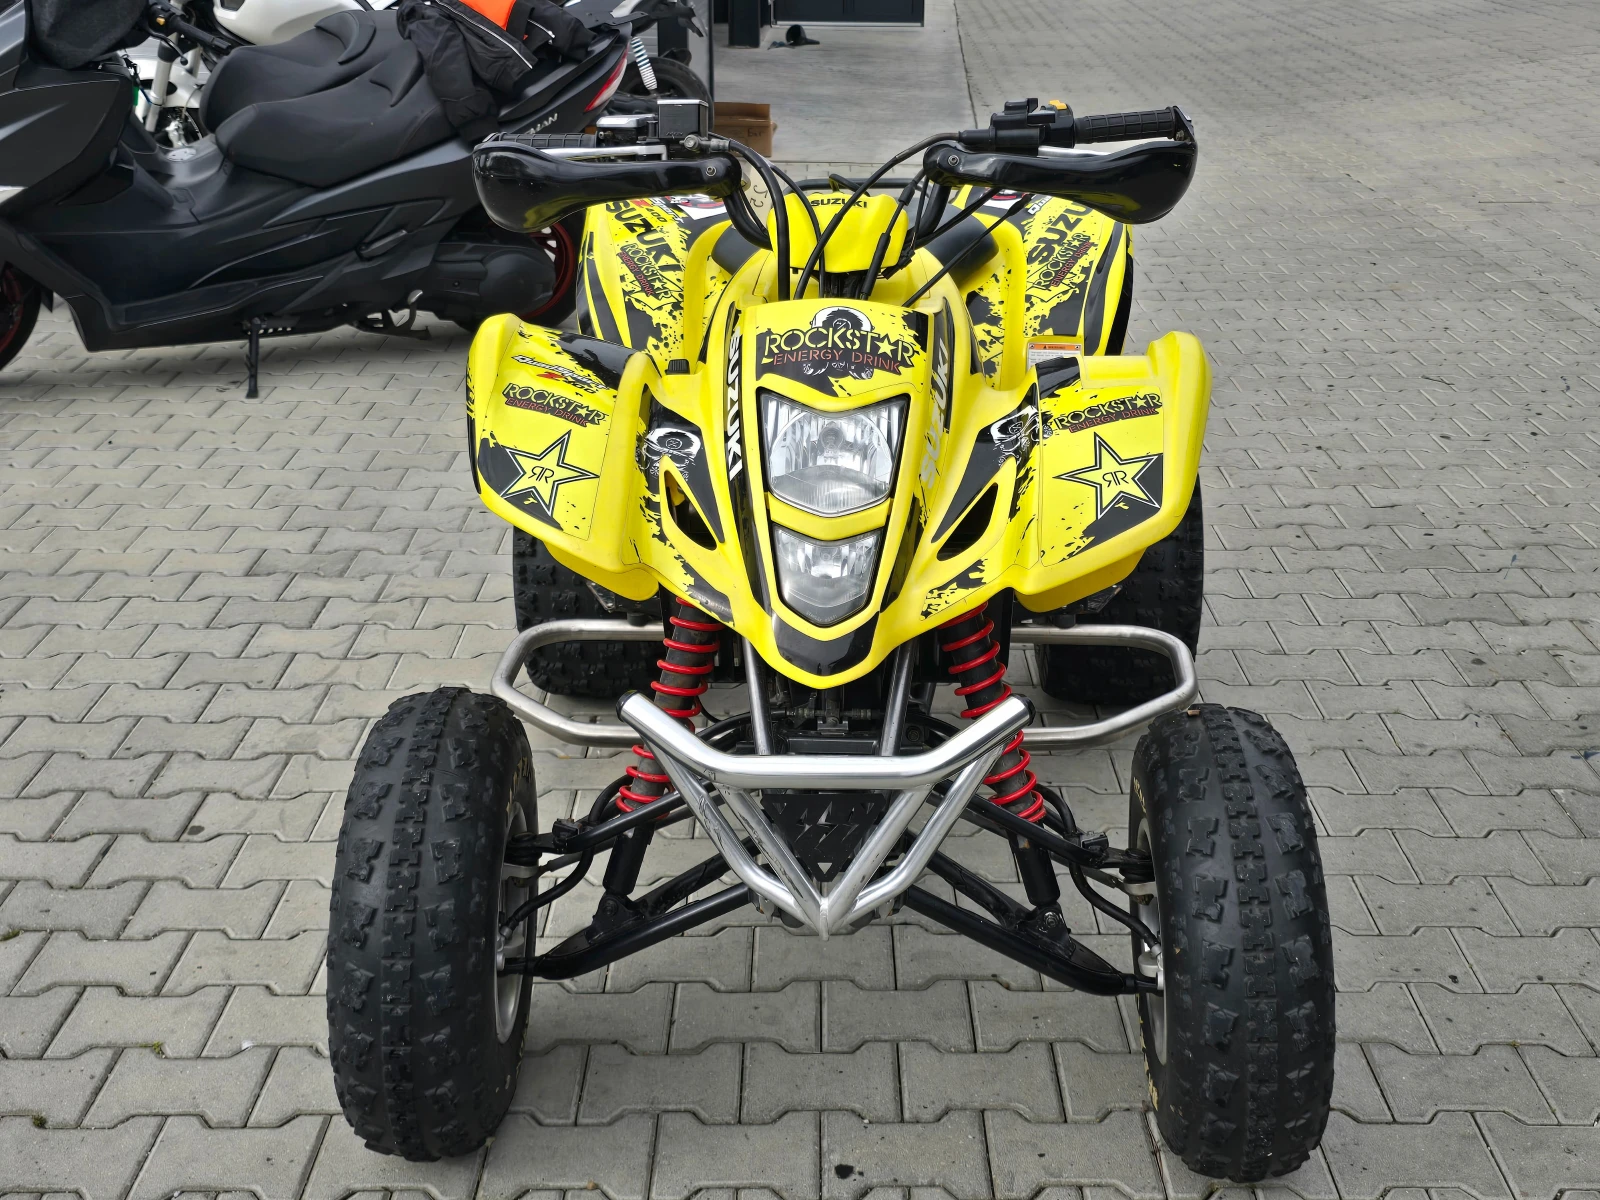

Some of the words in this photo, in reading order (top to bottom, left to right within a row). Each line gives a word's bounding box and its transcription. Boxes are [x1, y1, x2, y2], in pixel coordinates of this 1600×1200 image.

[605, 199, 681, 273] SUZUKI
[1026, 201, 1095, 266] SUZU
[763, 326, 916, 367] ROCKSTAR
[773, 349, 844, 366] ENERGY
[850, 351, 901, 375] DRINK
[506, 397, 552, 413] ENERGY
[553, 408, 588, 427] DRINK
[727, 327, 744, 482] SUZUKI
[920, 337, 949, 490] SUZUKI
[1068, 413, 1118, 433] ENERGY
[1121, 407, 1158, 419] DRINK
